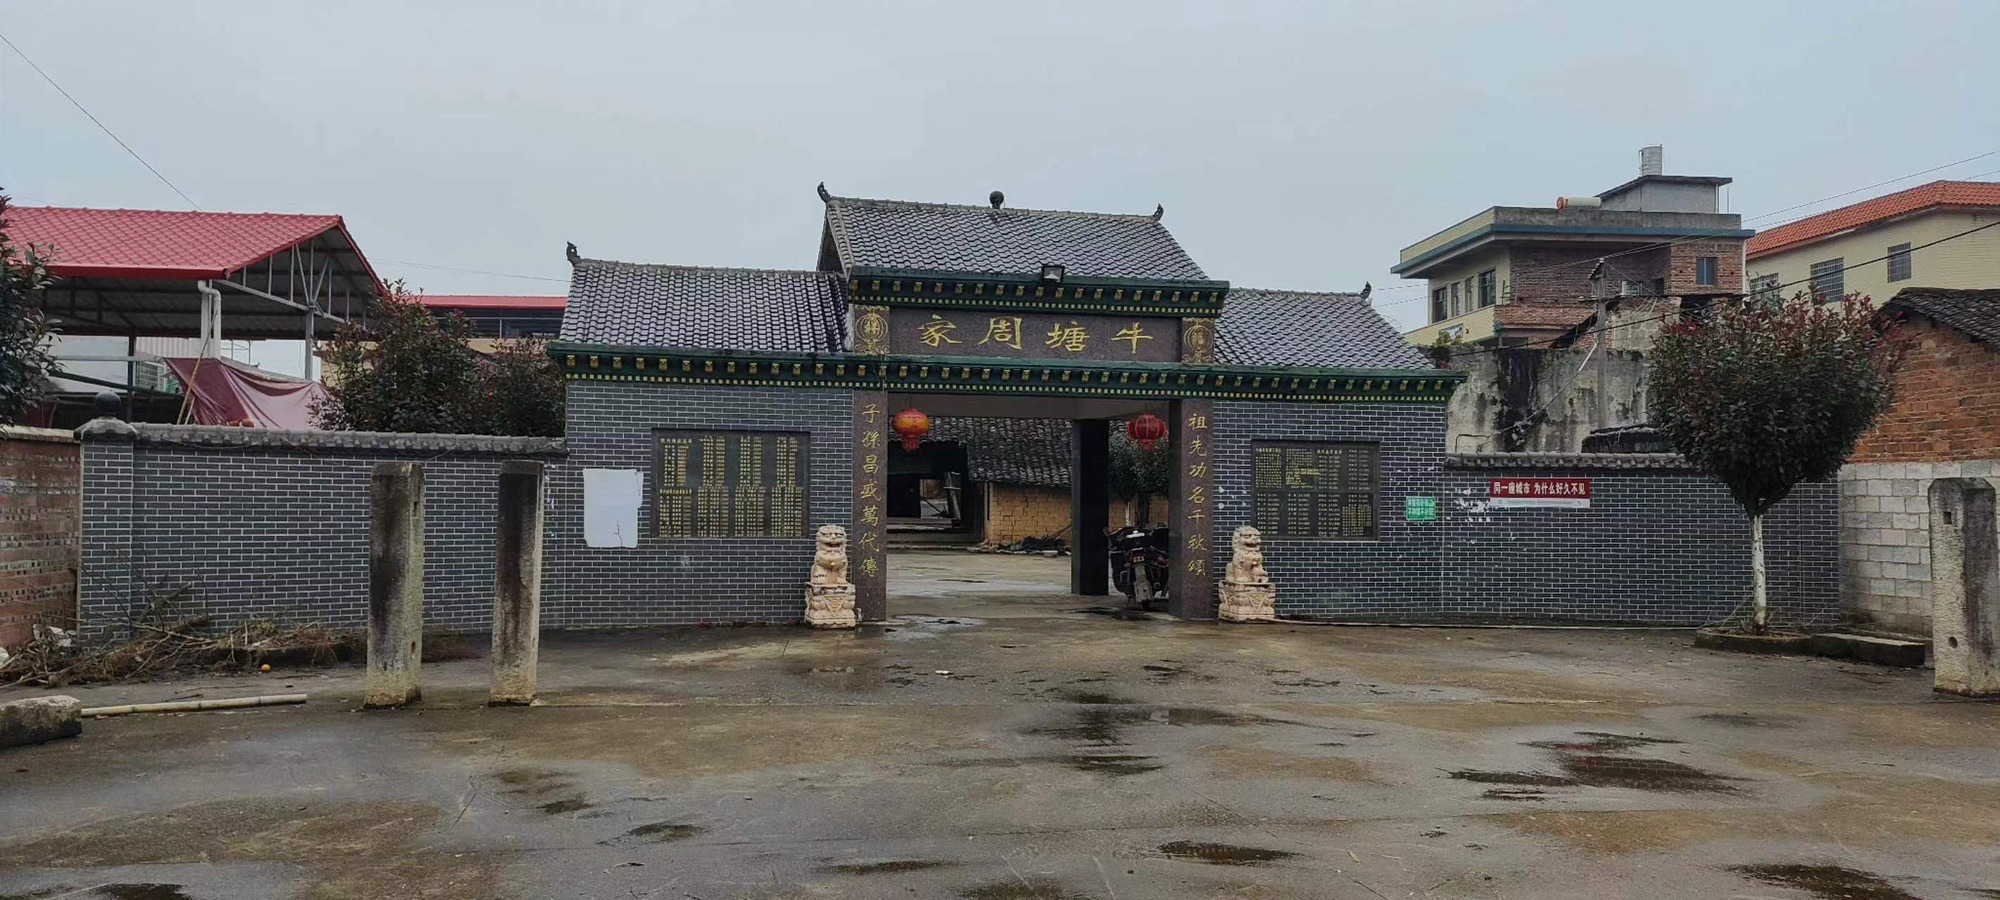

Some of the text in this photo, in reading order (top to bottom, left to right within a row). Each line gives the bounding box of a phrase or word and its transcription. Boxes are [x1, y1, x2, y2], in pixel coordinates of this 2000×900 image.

[1493, 481, 1586, 495] 同一座城市 为什么好久不见
